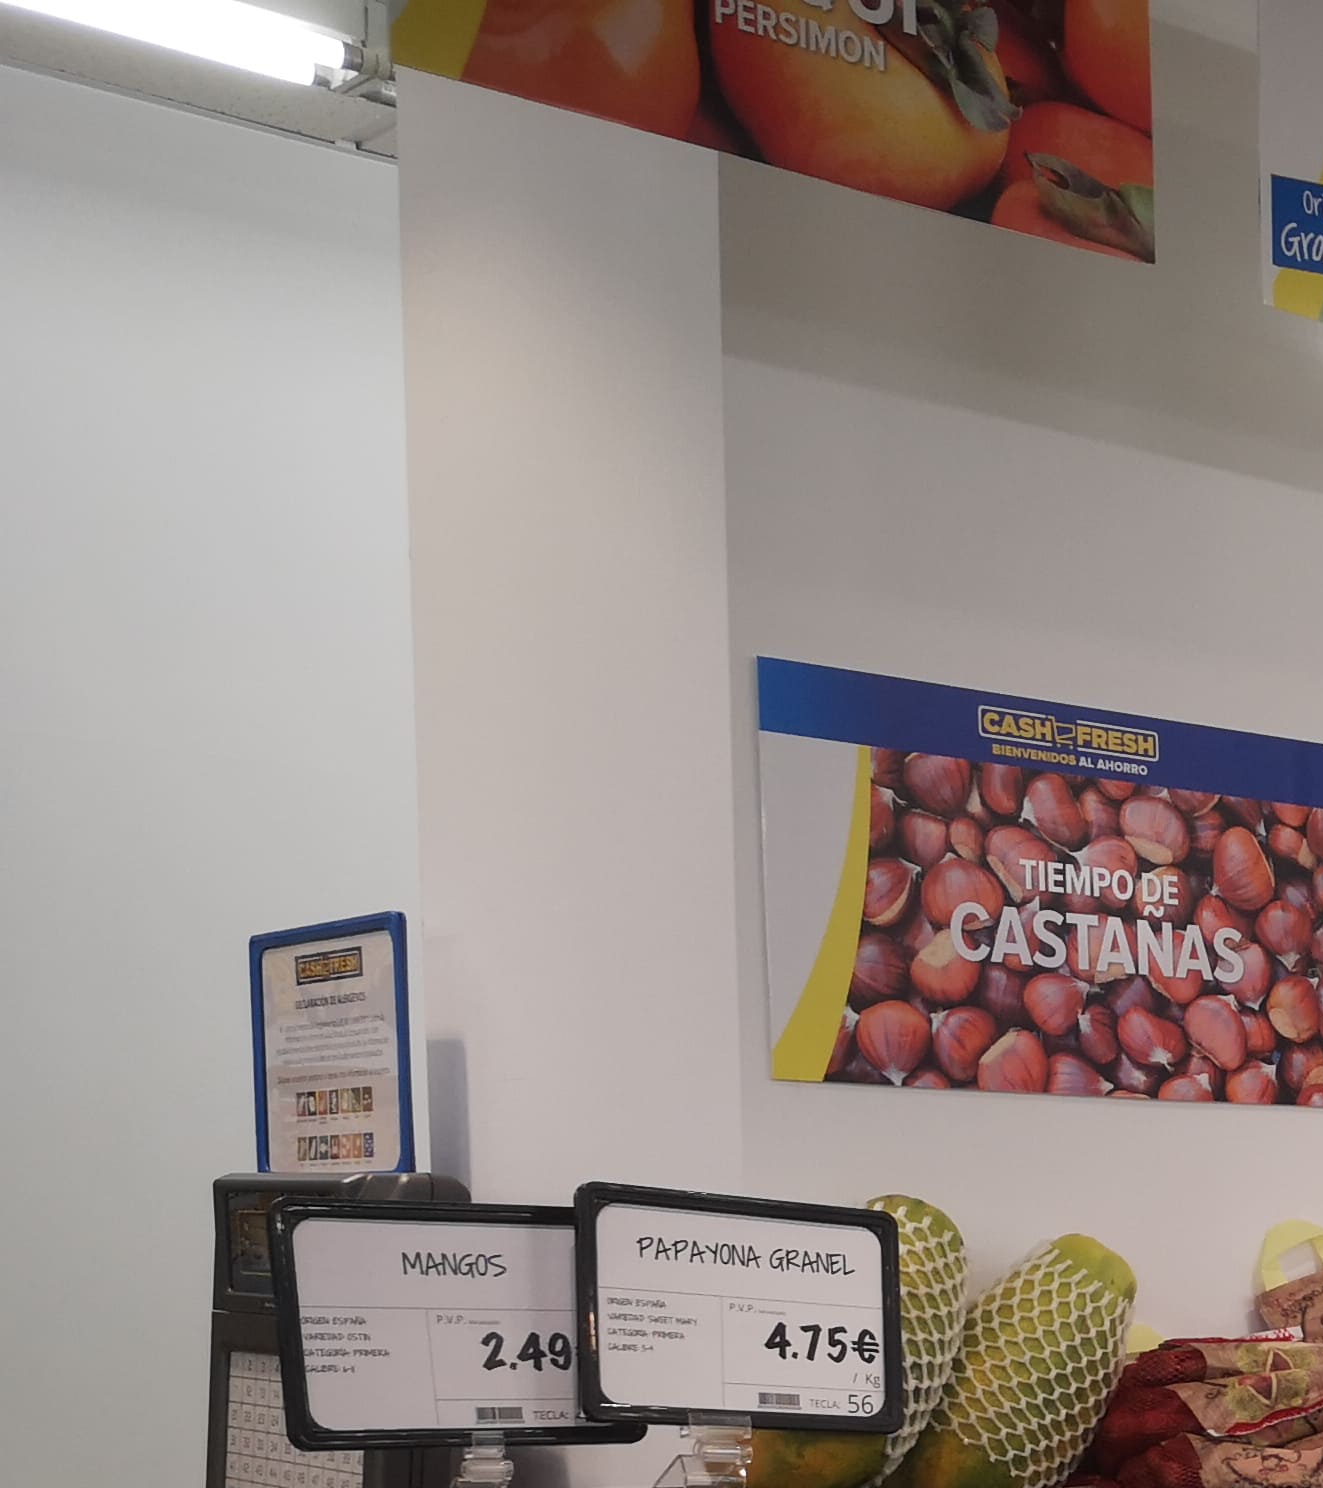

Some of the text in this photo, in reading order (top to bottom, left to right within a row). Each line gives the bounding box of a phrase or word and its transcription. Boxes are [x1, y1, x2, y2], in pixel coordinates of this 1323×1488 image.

[715, 0, 886, 72] PERSIMON
[982, 711, 1155, 757] CASH FRESH
[992, 743, 1148, 776] BIENVENIDOS AL AHORRO
[1018, 858, 1180, 907] TIEMPO DE
[949, 900, 1246, 985] CASTAÑAS
[400, 1251, 508, 1280] MANGOS
[636, 1236, 856, 1276] PAPAYONA GRANEL
[764, 1322, 880, 1364] 4.75€
[864, 1373, 881, 1389] Kg
[808, 1392, 875, 1416] TECLA: 56
